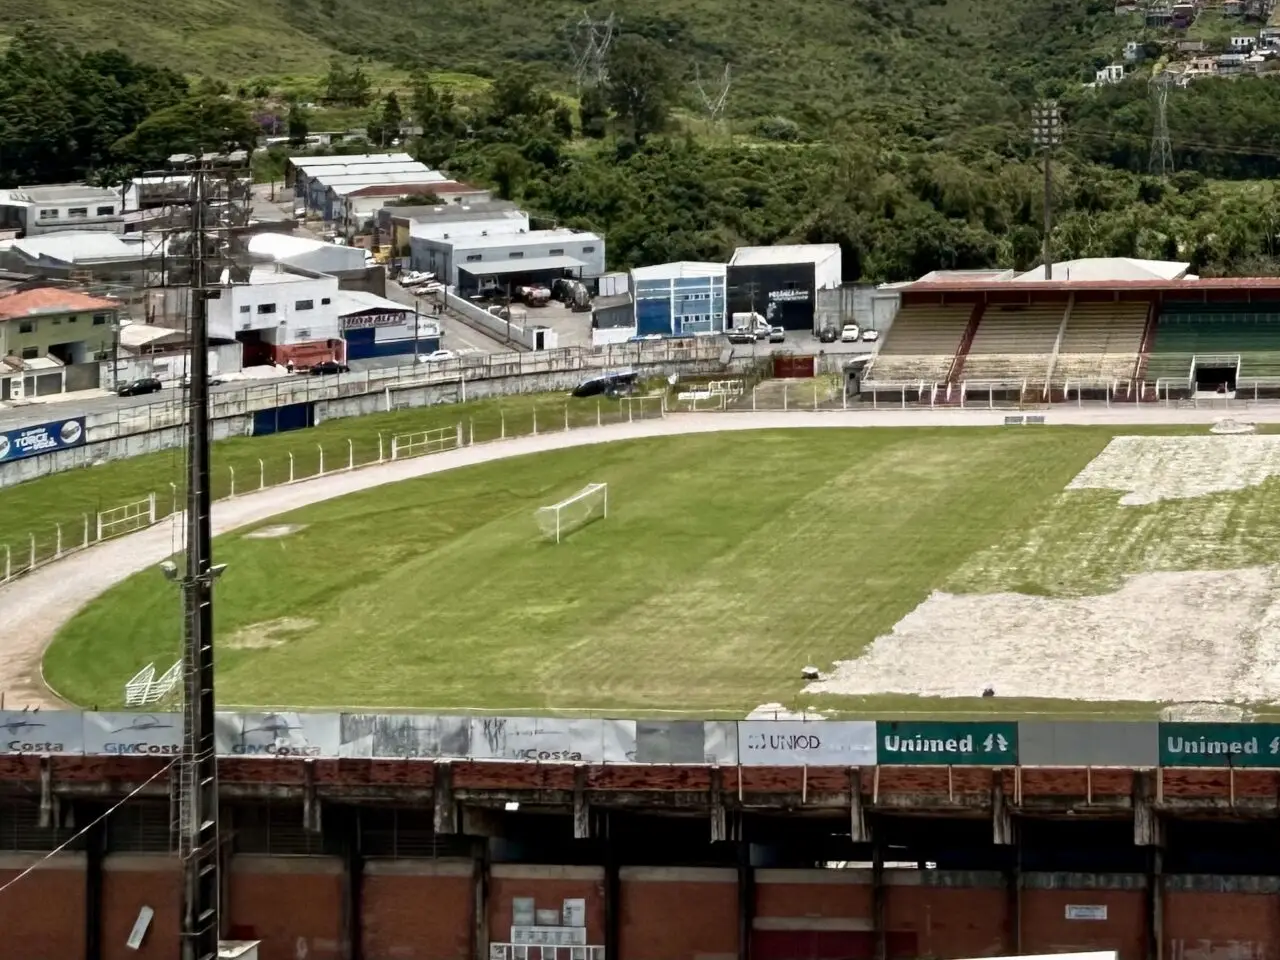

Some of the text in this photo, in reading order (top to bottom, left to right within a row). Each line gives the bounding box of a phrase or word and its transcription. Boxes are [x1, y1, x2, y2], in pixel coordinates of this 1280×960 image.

[14, 432, 48, 448] TORCE
[104, 742, 181, 754] GMCost
[884, 734, 973, 753] Unimed
[1167, 735, 1259, 754] Unimed
